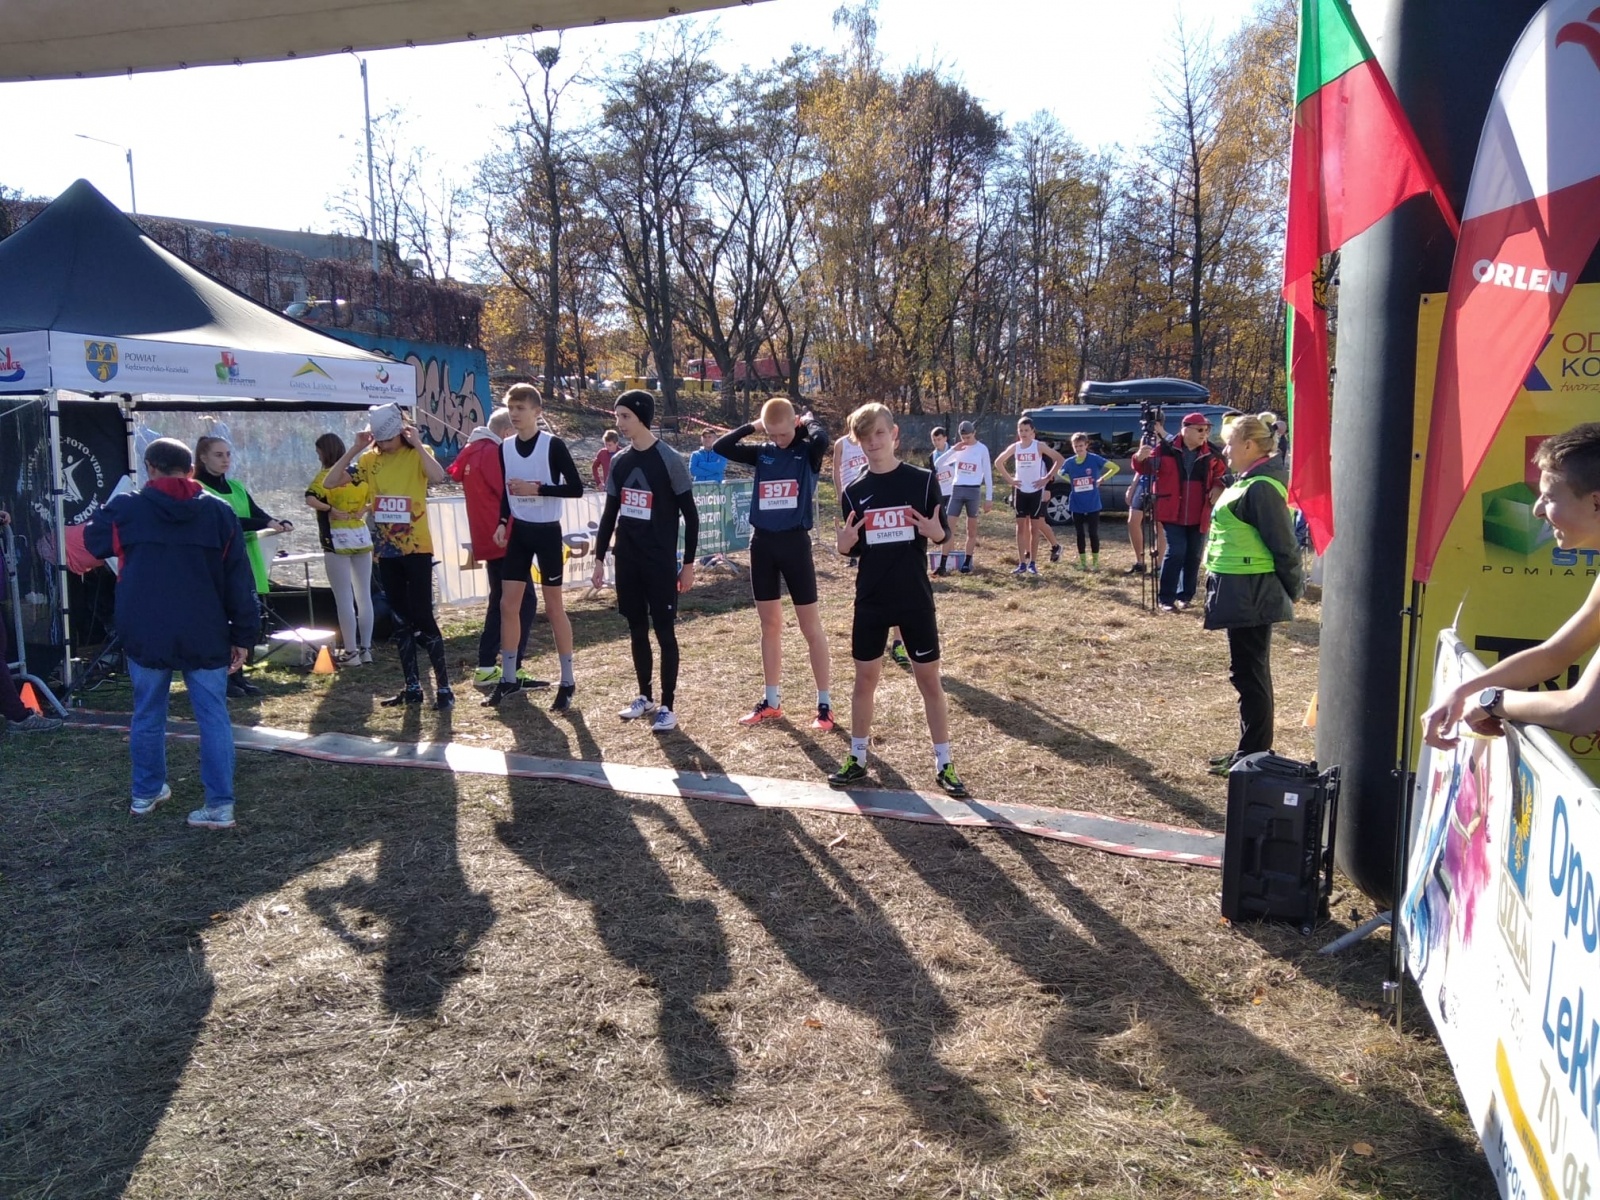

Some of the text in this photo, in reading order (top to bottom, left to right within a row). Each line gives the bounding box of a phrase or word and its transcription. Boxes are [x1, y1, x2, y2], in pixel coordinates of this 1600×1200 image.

[1473, 259, 1568, 294] ORLEN
[125, 353, 156, 362] POWIAT
[1560, 381, 1600, 393] tworz
[960, 463, 974, 471] 412
[764, 482, 791, 497] 397
[378, 498, 406, 511] 400
[625, 490, 648, 507] 396
[873, 510, 905, 528] 401
[1552, 547, 1600, 567] ST
[1483, 565, 1597, 577] POMIAR
[1549, 795, 1600, 970] Opo
[1500, 871, 1529, 979] OZLA
[1538, 1059, 1559, 1155] 70
